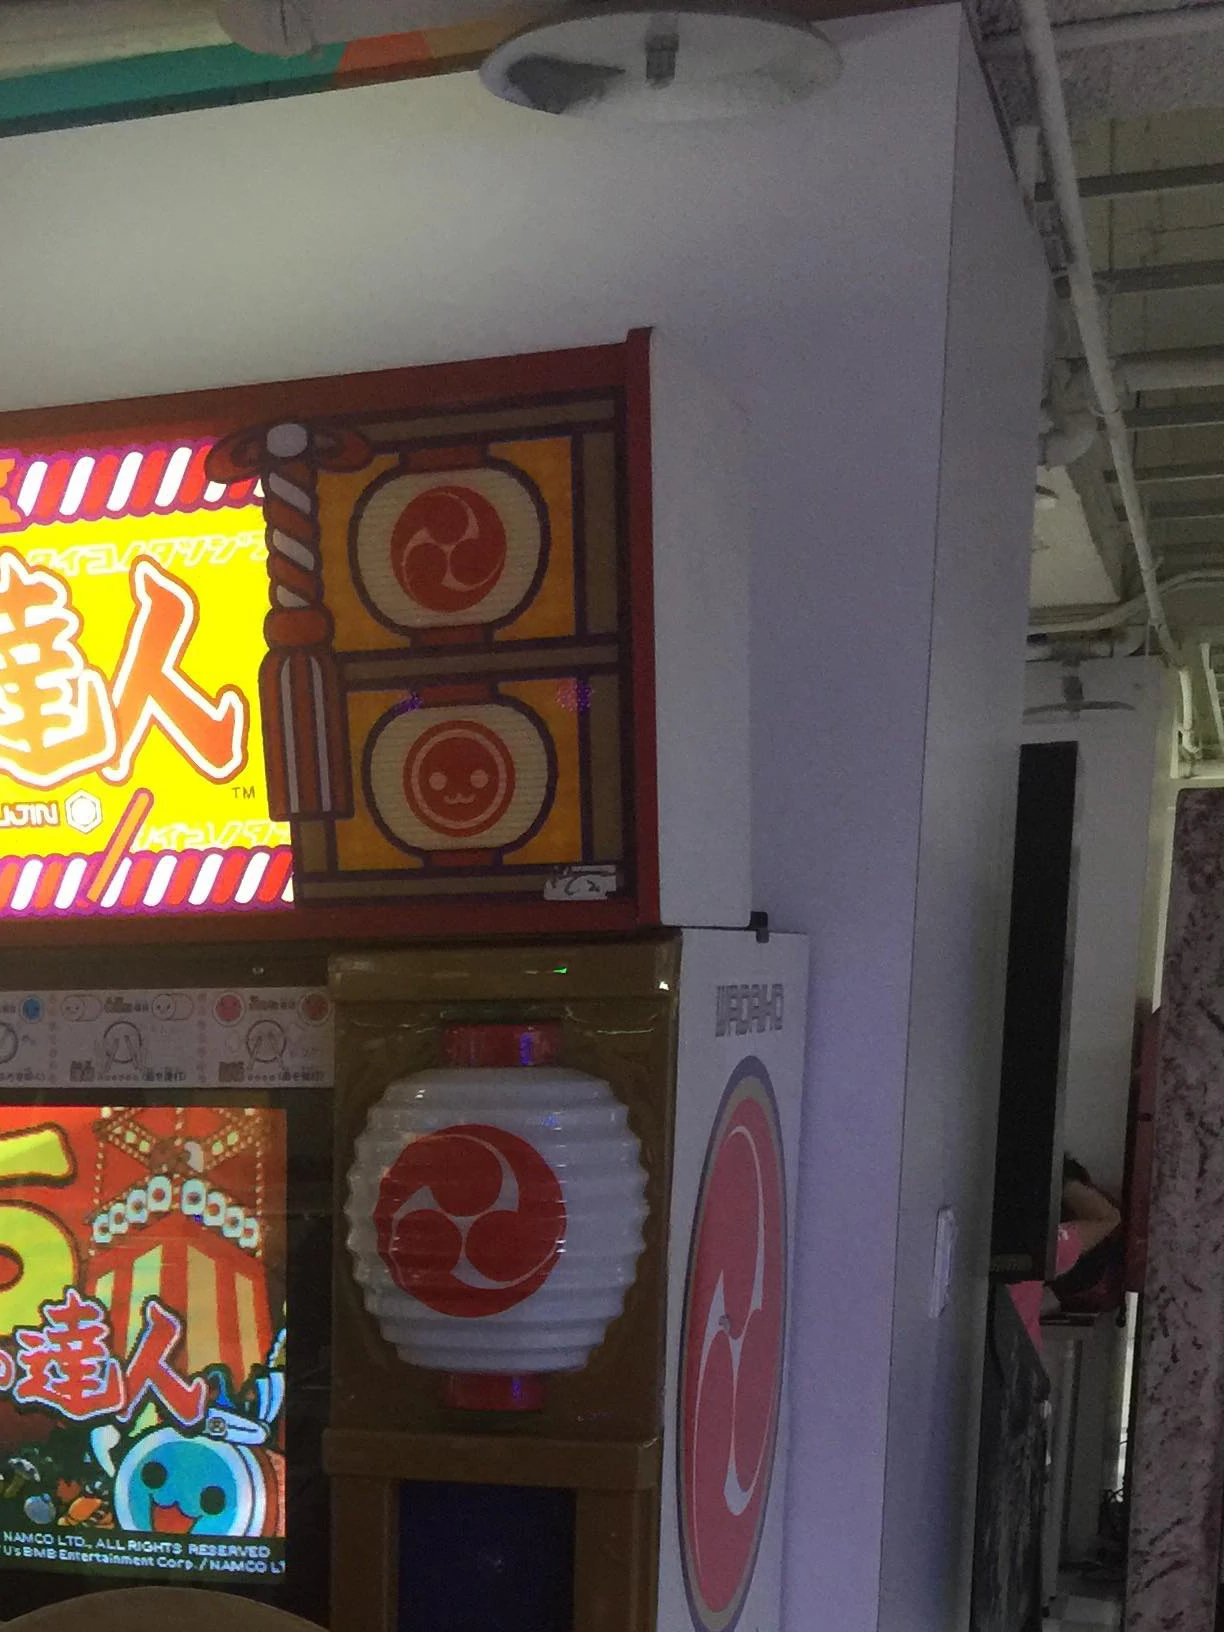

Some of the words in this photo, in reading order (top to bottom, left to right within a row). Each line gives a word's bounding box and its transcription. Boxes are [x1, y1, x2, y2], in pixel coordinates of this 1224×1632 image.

[3, 1531, 54, 1546] NAMCO
[95, 1537, 126, 1552] ALL
[127, 1540, 184, 1556] RIGHTS
[187, 1543, 271, 1560] RESERVED
[59, 1549, 154, 1567] Entertainment
[209, 1560, 266, 1574] NAMCO
